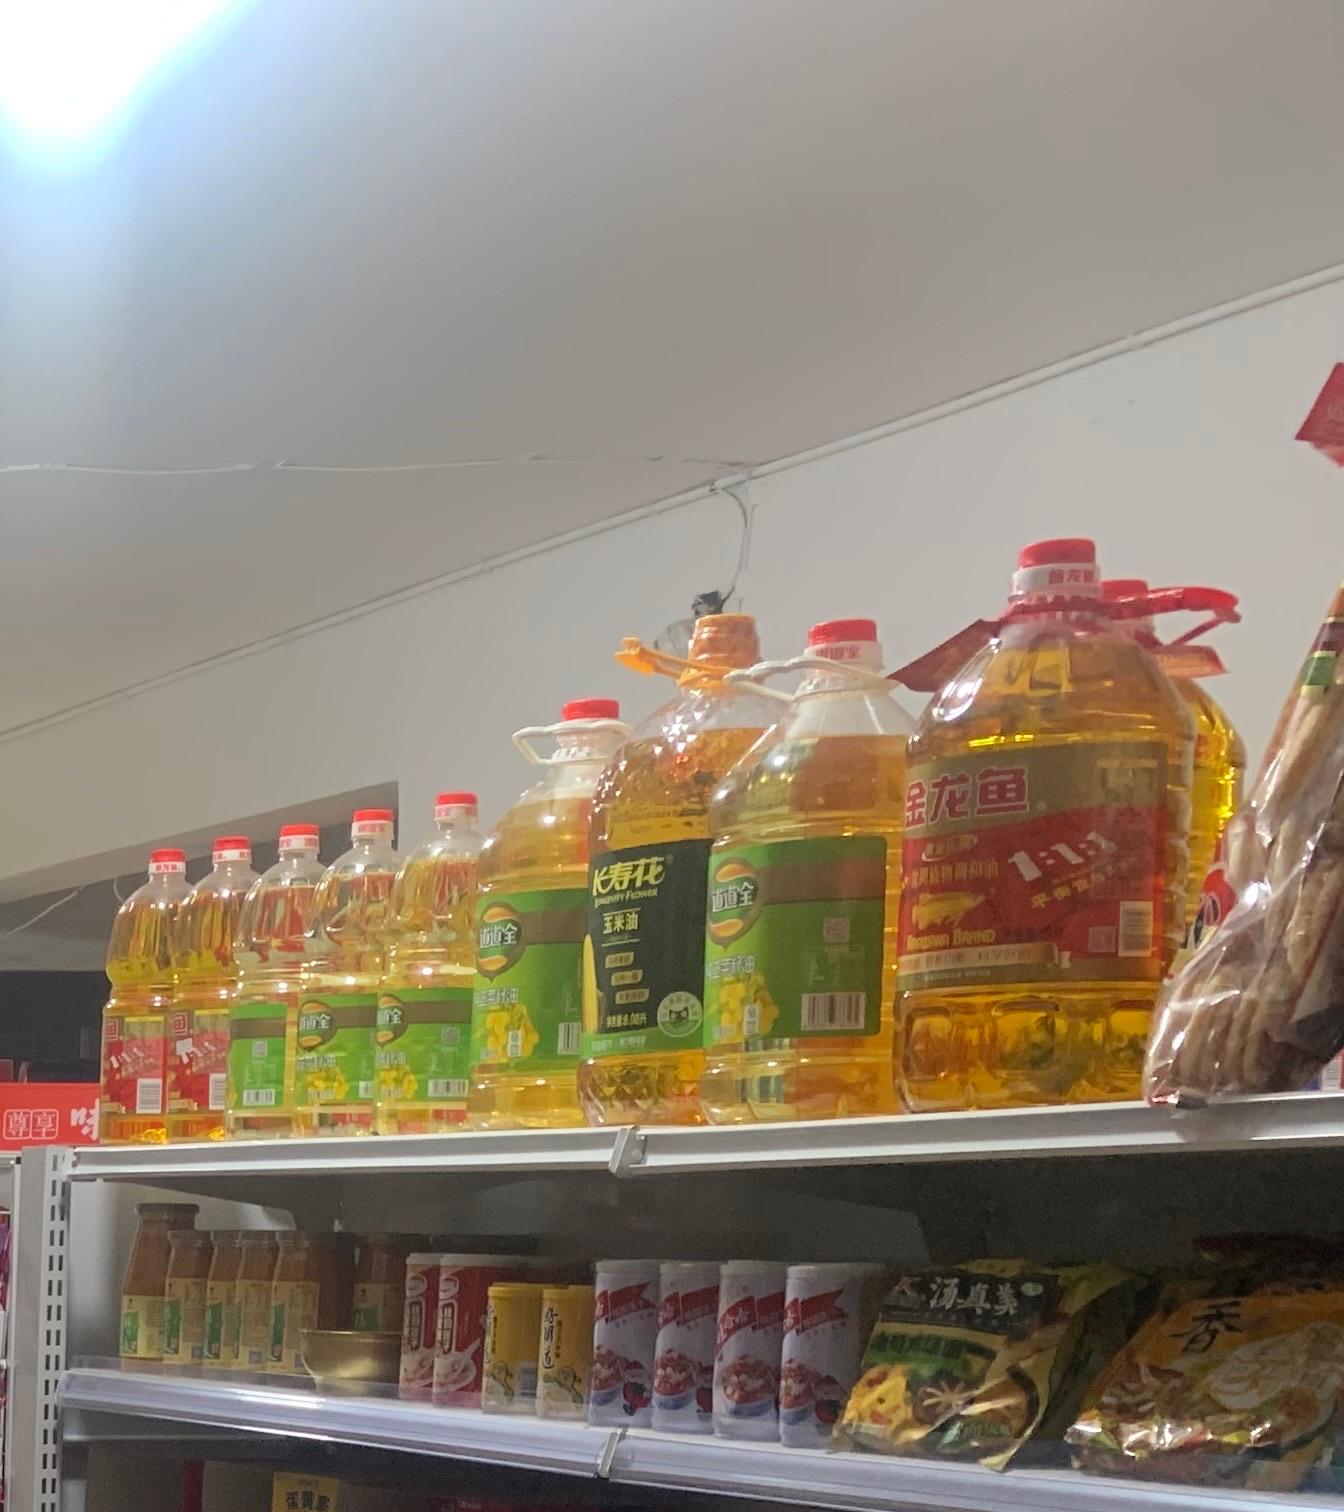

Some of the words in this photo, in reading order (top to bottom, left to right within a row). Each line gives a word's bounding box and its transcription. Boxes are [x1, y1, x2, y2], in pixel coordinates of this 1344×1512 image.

[592, 856, 666, 896] 长寿花
[602, 912, 639, 935] 玉米油
[6, 1111, 58, 1137] 尊享
